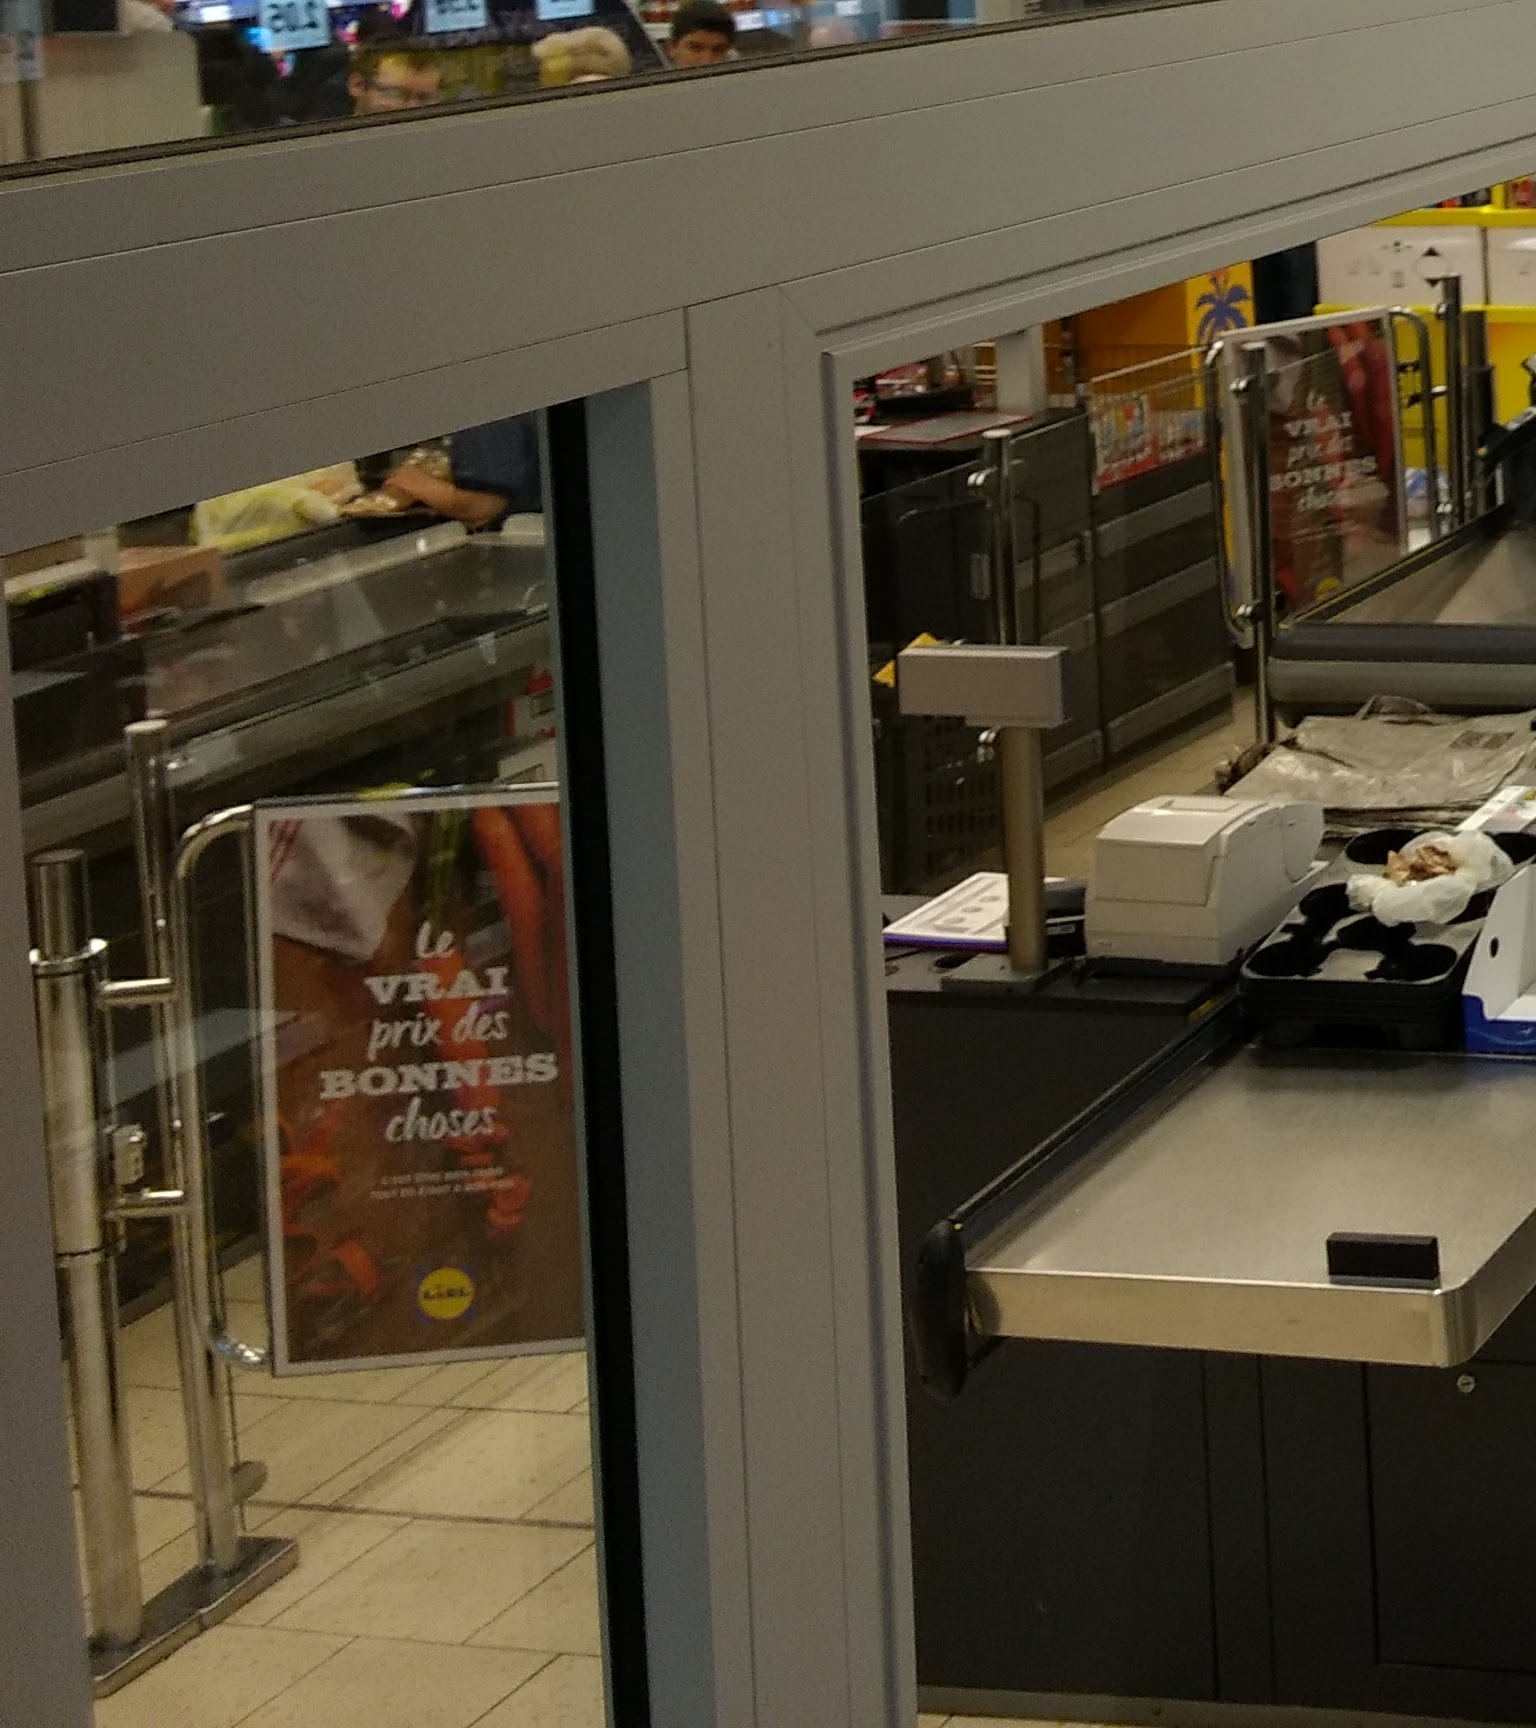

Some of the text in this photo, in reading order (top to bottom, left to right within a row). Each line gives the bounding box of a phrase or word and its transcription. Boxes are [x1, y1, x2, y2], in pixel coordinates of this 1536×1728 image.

[364, 966, 509, 1005] VRAI
[366, 1001, 510, 1062] prix des
[319, 1053, 559, 1100] BONNES
[383, 1096, 498, 1143] choses
